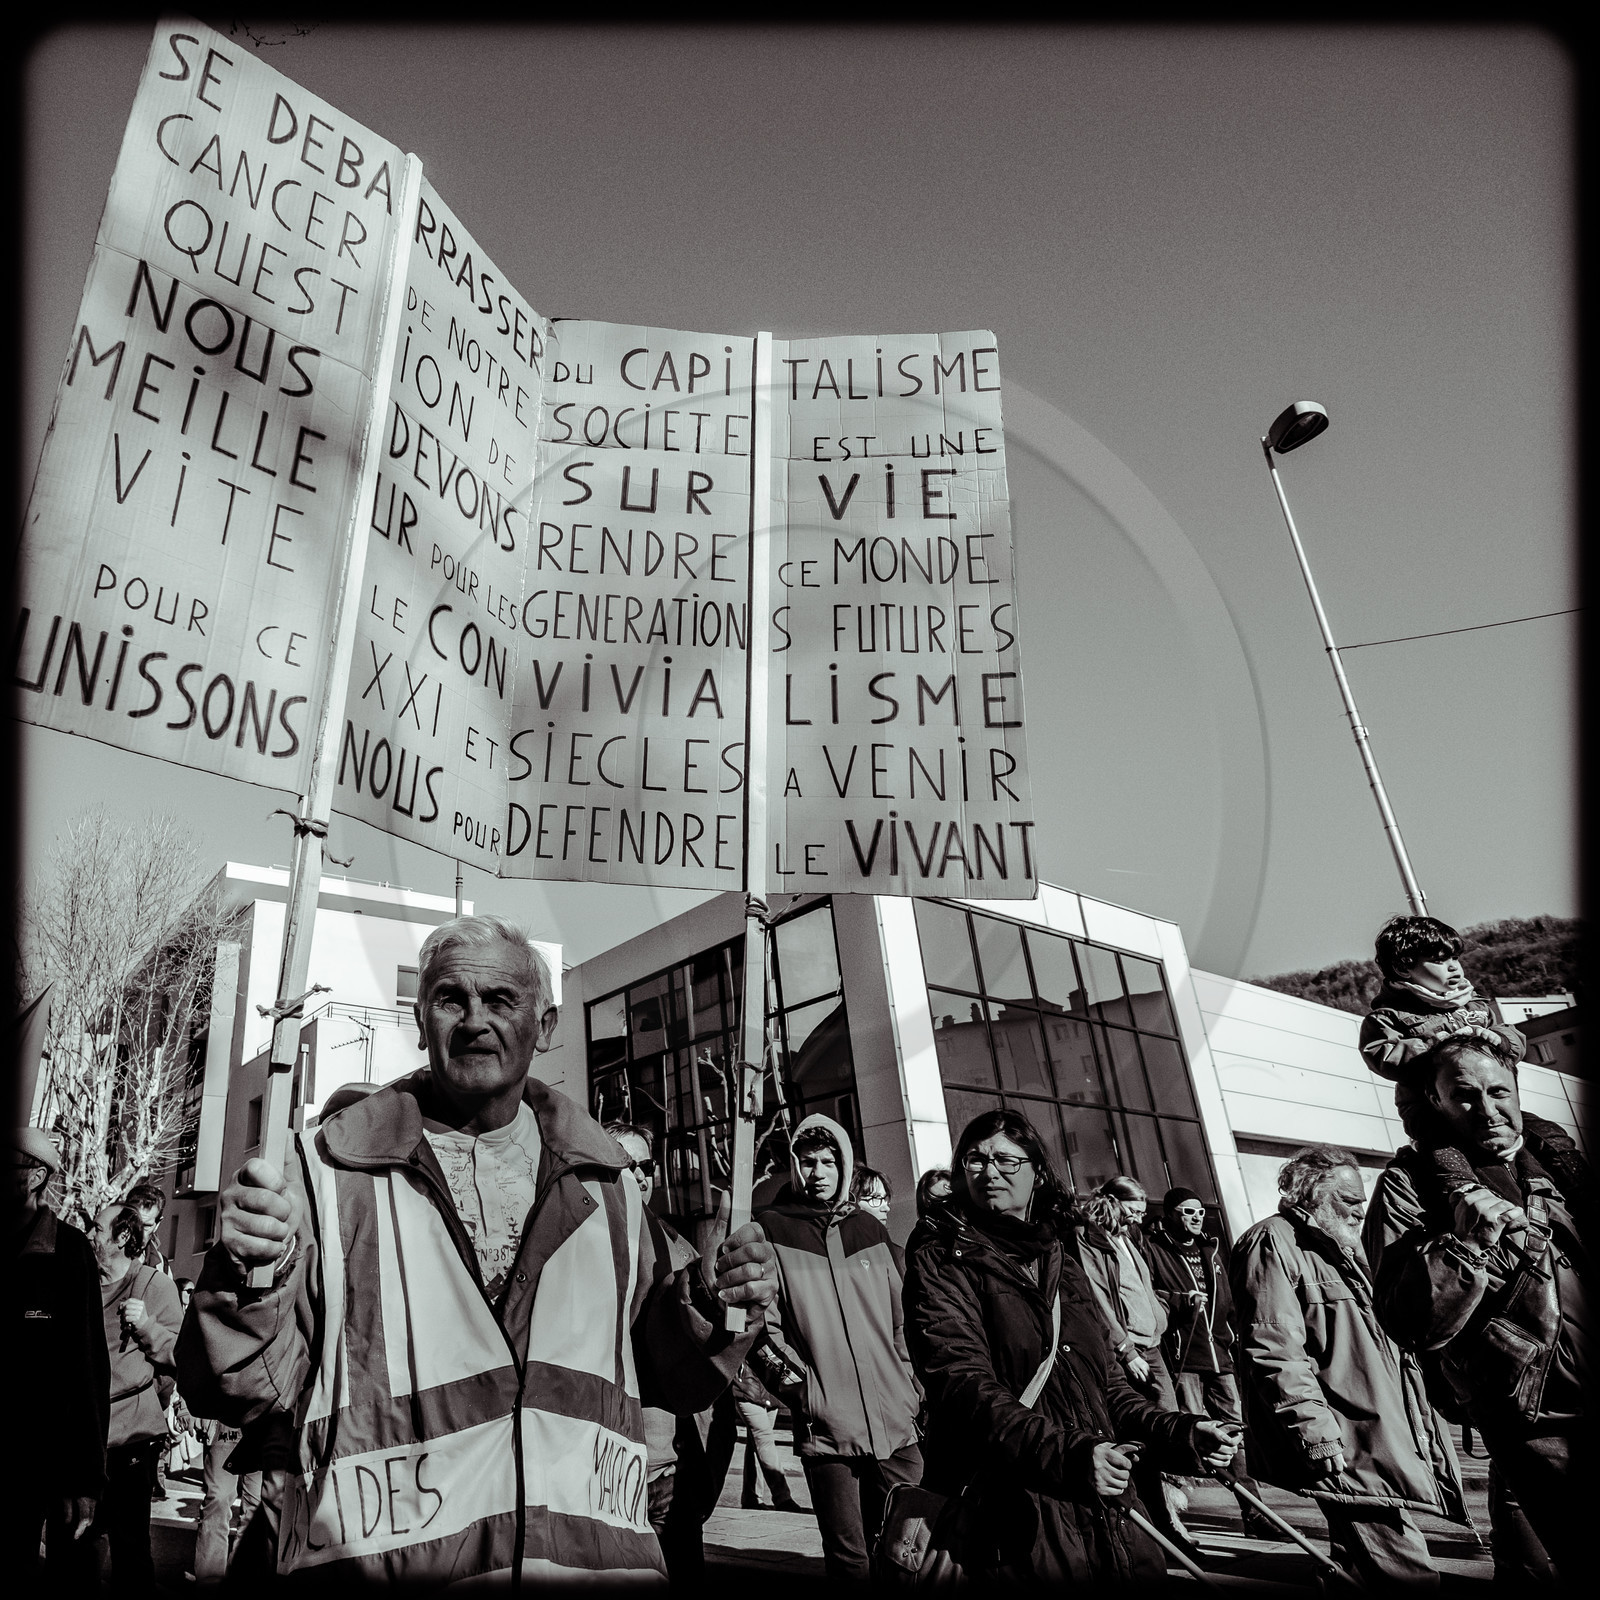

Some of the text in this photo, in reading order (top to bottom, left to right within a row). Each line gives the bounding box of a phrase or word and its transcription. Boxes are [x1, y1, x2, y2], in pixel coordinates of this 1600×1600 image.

[156, 113, 367, 268] CANCER
[407, 286, 435, 332] DE
[448, 316, 529, 428] NOTRE
[813, 436, 876, 461] EST
[911, 428, 997, 458] UNE
[159, 33, 234, 113] SE
[552, 362, 593, 384] DU
[125, 259, 1000, 587] NOUS DEVONS RENDRE CE MONDE
[488, 438, 516, 485] DE
[563, 461, 714, 515] SUR
[94, 563, 208, 636] POUR
[256, 626, 307, 667] CE
[362, 640, 442, 737] XXI
[466, 726, 499, 769] ET
[784, 767, 802, 797] A
[371, 584, 408, 634] LE
[431, 543, 479, 603] POUR
[487, 585, 517, 630] LES
[833, 603, 1015, 654] FUTURES
[338, 719, 443, 823] NOUS
[453, 811, 501, 856] POUR
[506, 802, 737, 870] DEFENDRE
[776, 843, 828, 875] LE
